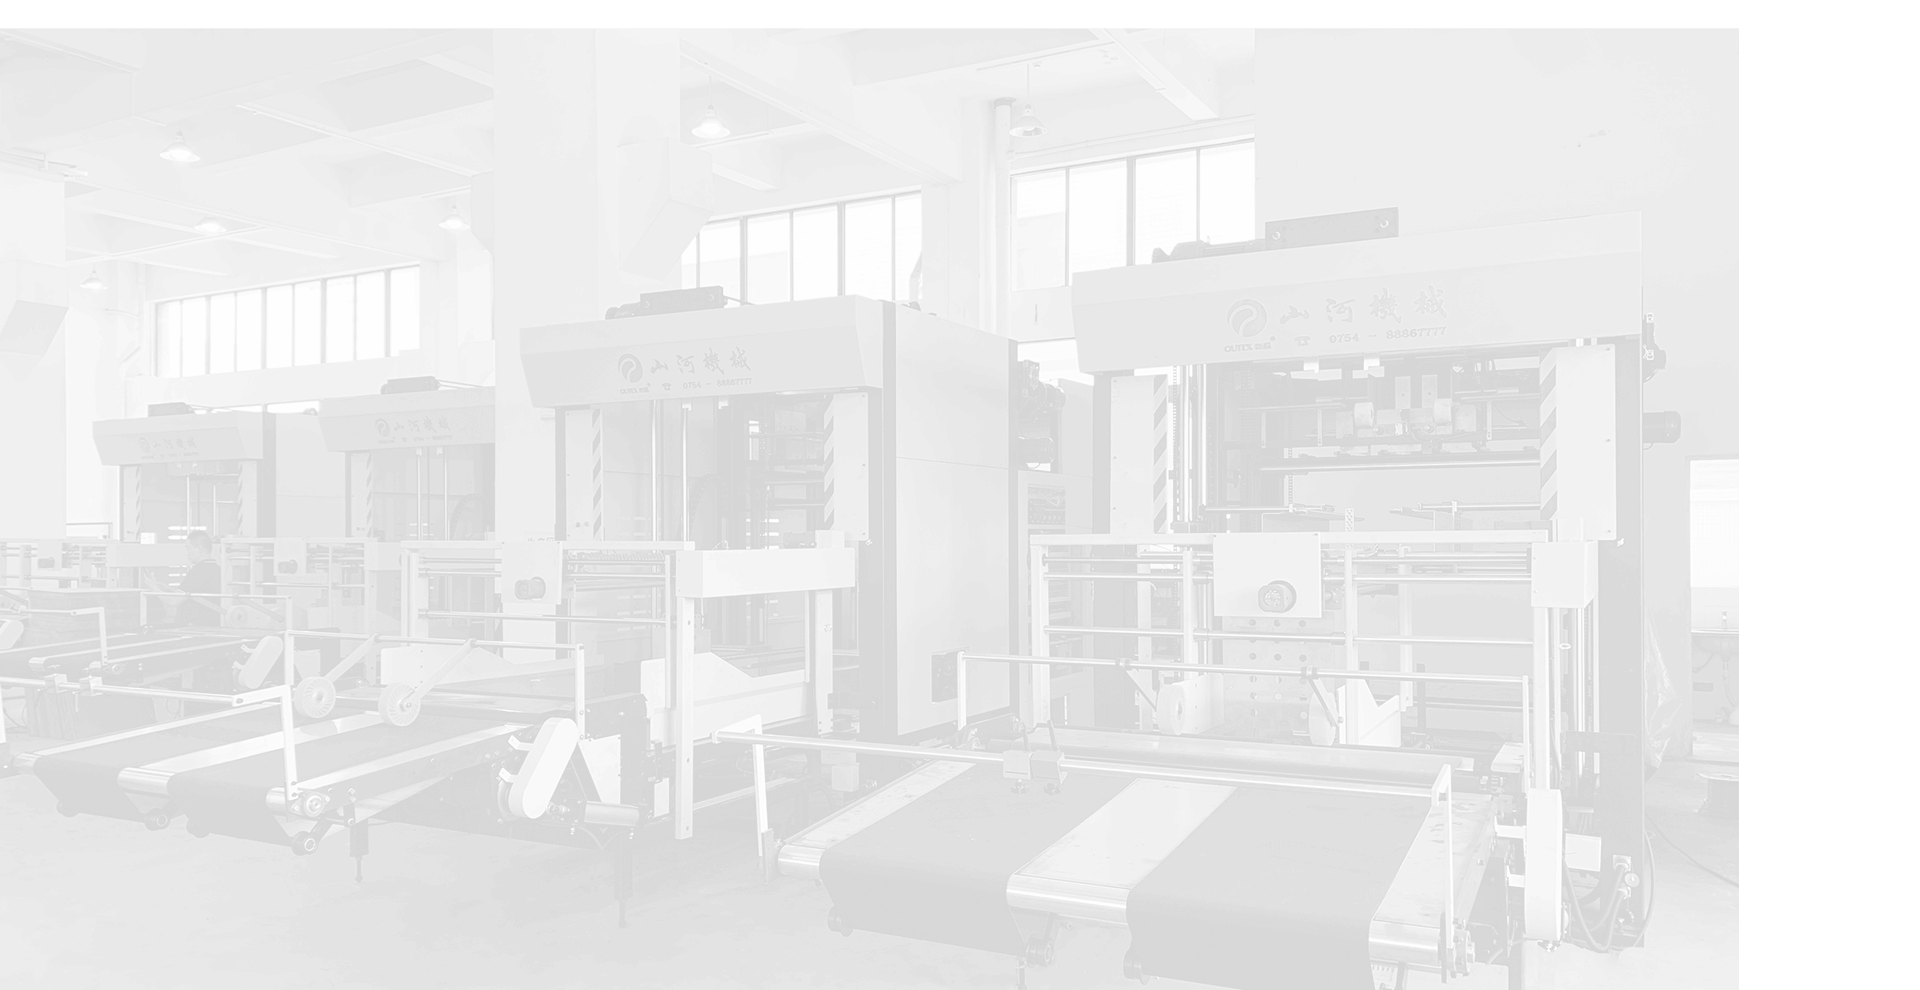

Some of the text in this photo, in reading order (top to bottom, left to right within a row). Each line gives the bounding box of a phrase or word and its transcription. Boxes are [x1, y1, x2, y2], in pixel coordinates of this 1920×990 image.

[1279, 285, 1447, 324] 山河機械
[1329, 333, 1360, 343] 0754
[1386, 326, 1447, 339] 88867777
[650, 346, 751, 375] 山河機械
[682, 381, 702, 389] 0754
